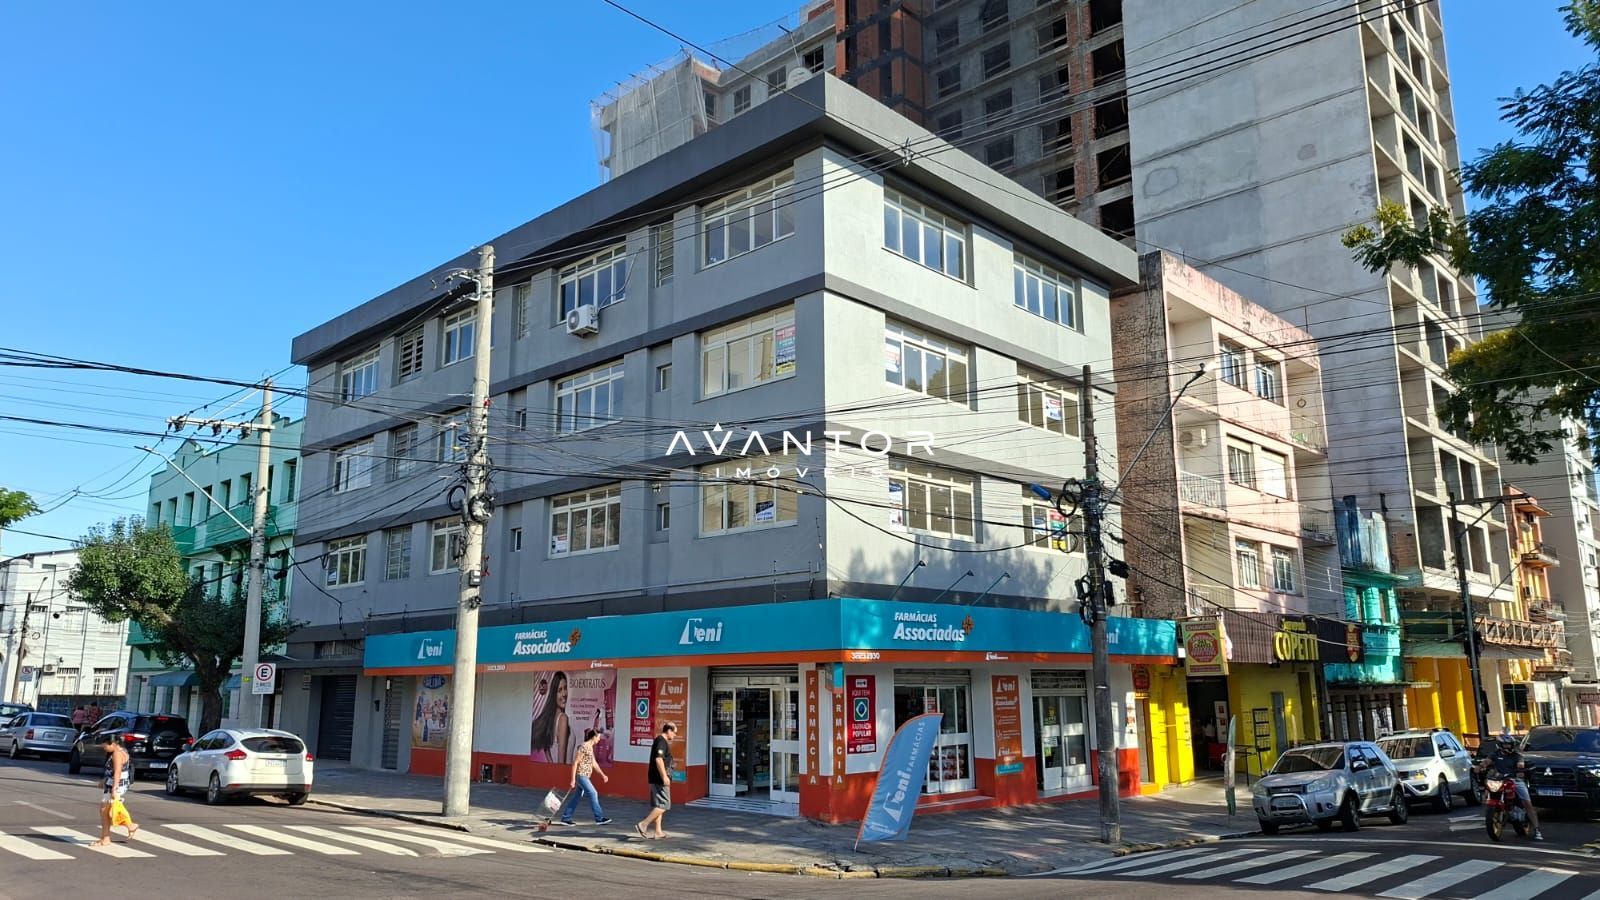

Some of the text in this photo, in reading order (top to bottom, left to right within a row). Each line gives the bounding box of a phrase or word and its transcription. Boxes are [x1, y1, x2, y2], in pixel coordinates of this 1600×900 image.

[894, 610, 937, 623] FARMÁCIAS
[893, 623, 965, 642] Associadas
[512, 638, 571, 656] Associadas
[261, 668, 268, 678] E
